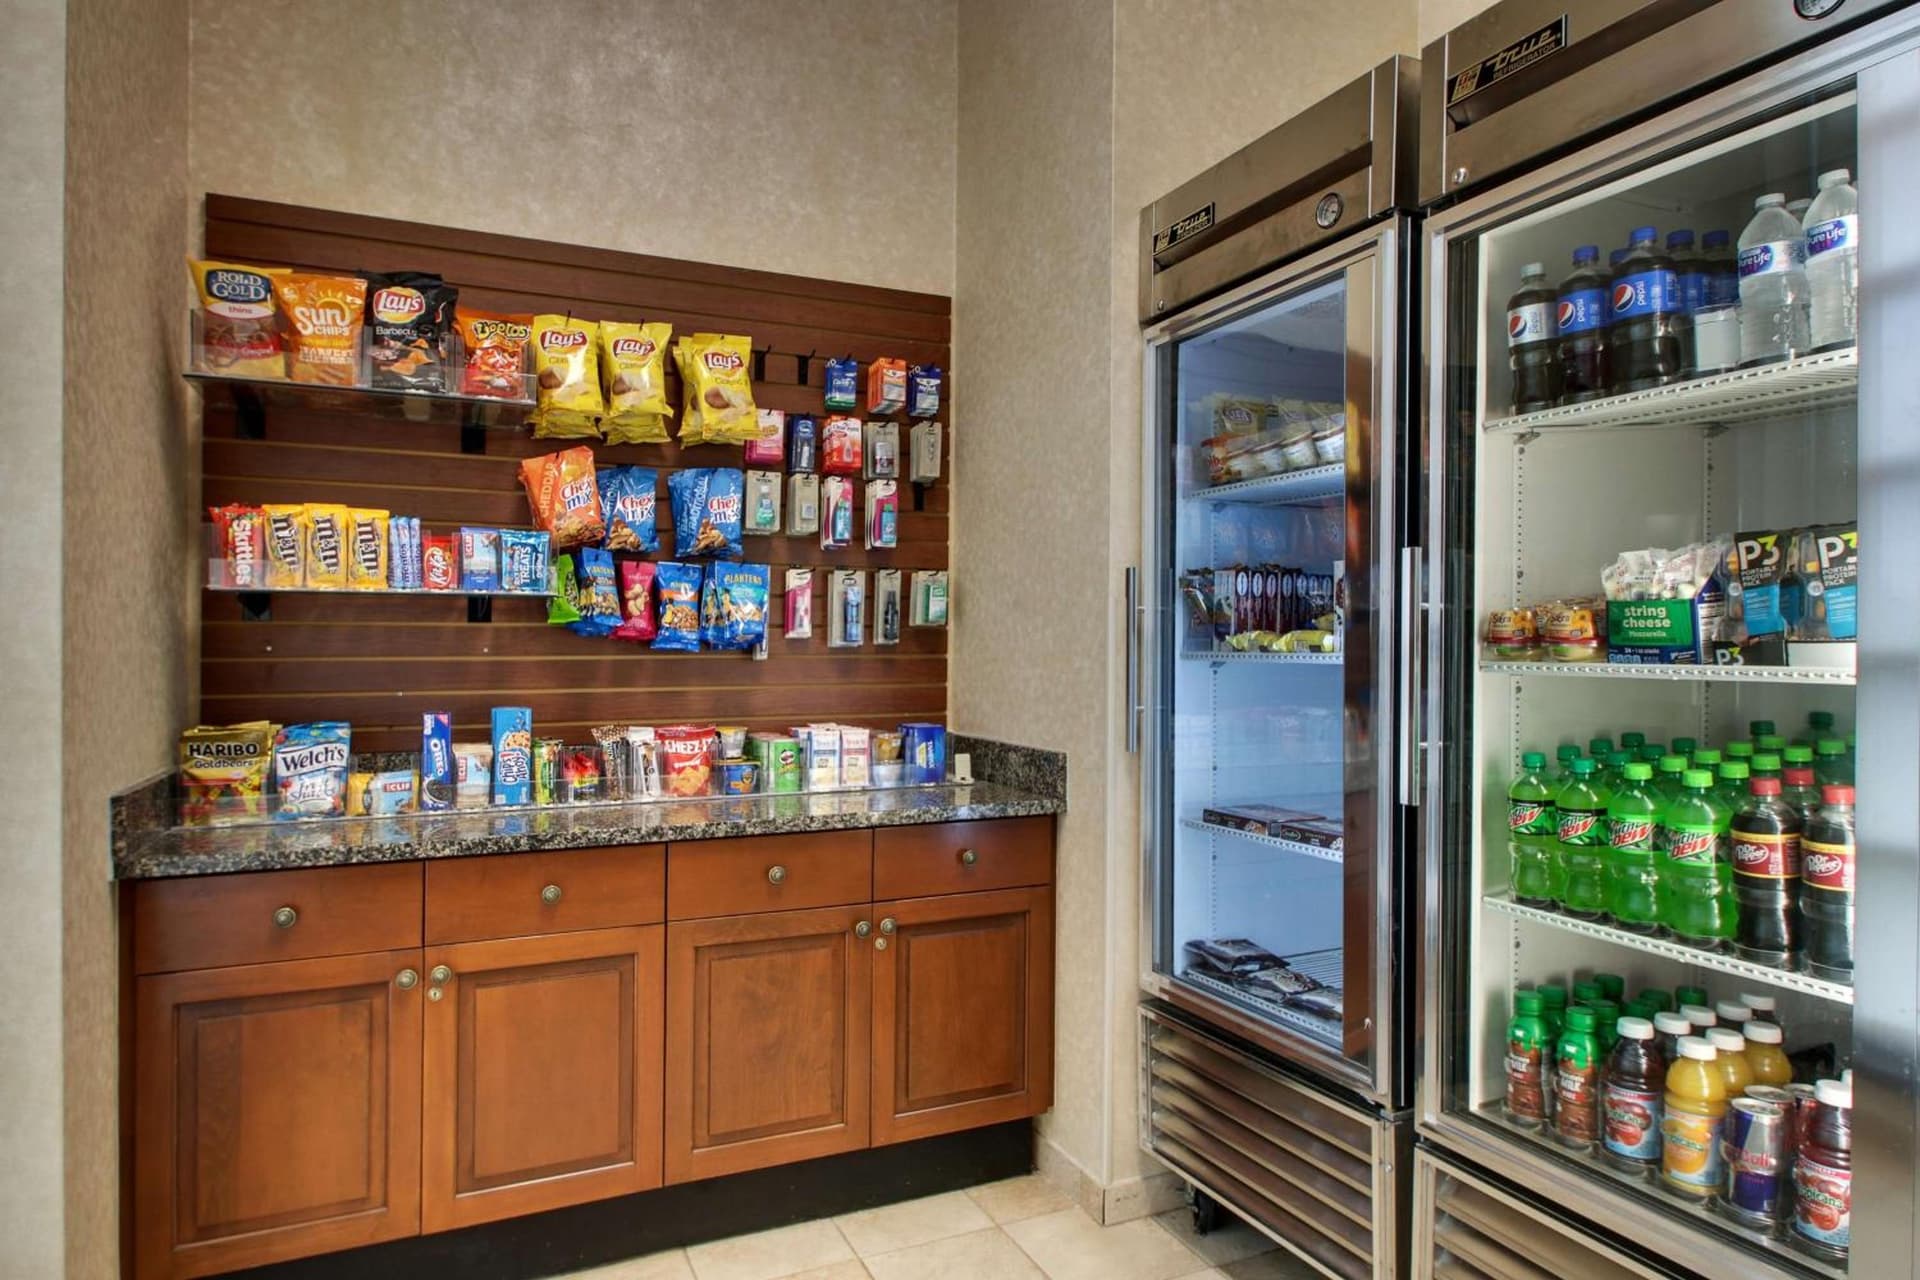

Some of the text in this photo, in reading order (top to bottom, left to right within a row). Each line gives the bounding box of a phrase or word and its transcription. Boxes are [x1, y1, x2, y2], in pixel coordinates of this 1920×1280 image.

[1826, 227, 1846, 241] Life
[217, 271, 265, 287] ROLD
[212, 283, 266, 300] GOLD
[378, 290, 423, 311] Lay's
[1637, 280, 1647, 306] pepsi
[294, 305, 351, 336] Sun
[314, 326, 351, 336] CHIPS
[543, 330, 584, 347] Lay's
[706, 351, 743, 369] Lay's
[561, 480, 594, 500] Chex
[233, 519, 254, 585] Skittles
[1737, 534, 1781, 569] P3
[520, 546, 530, 584] TREATS
[1624, 605, 1667, 618] string
[1623, 617, 1672, 628] cheese
[1715, 646, 1744, 666] P3
[188, 743, 258, 757] HARIBO
[282, 746, 345, 772] Welch's
[430, 738, 444, 776] OREO
[194, 759, 254, 769] Goldbears
